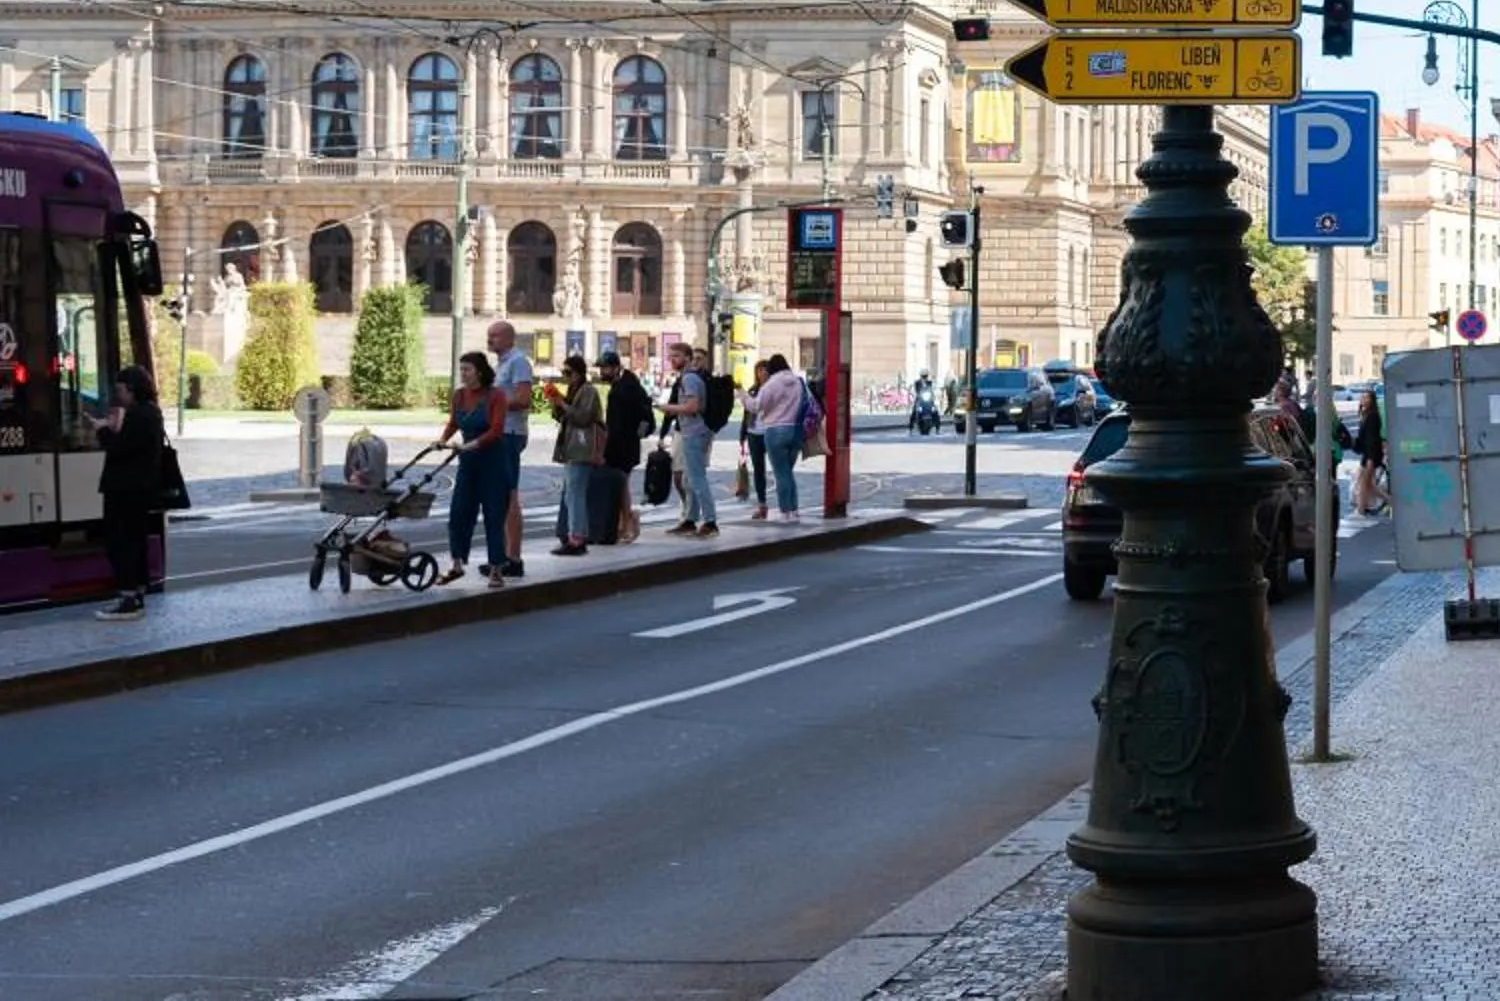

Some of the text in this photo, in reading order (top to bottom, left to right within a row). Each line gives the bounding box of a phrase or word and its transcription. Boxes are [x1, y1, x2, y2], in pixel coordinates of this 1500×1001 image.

[1065, 46, 1073, 66] 5
[1181, 43, 1221, 66] LIBEŇ
[1065, 70, 1193, 90] 2 FLORENC
[1294, 112, 1352, 196] P
